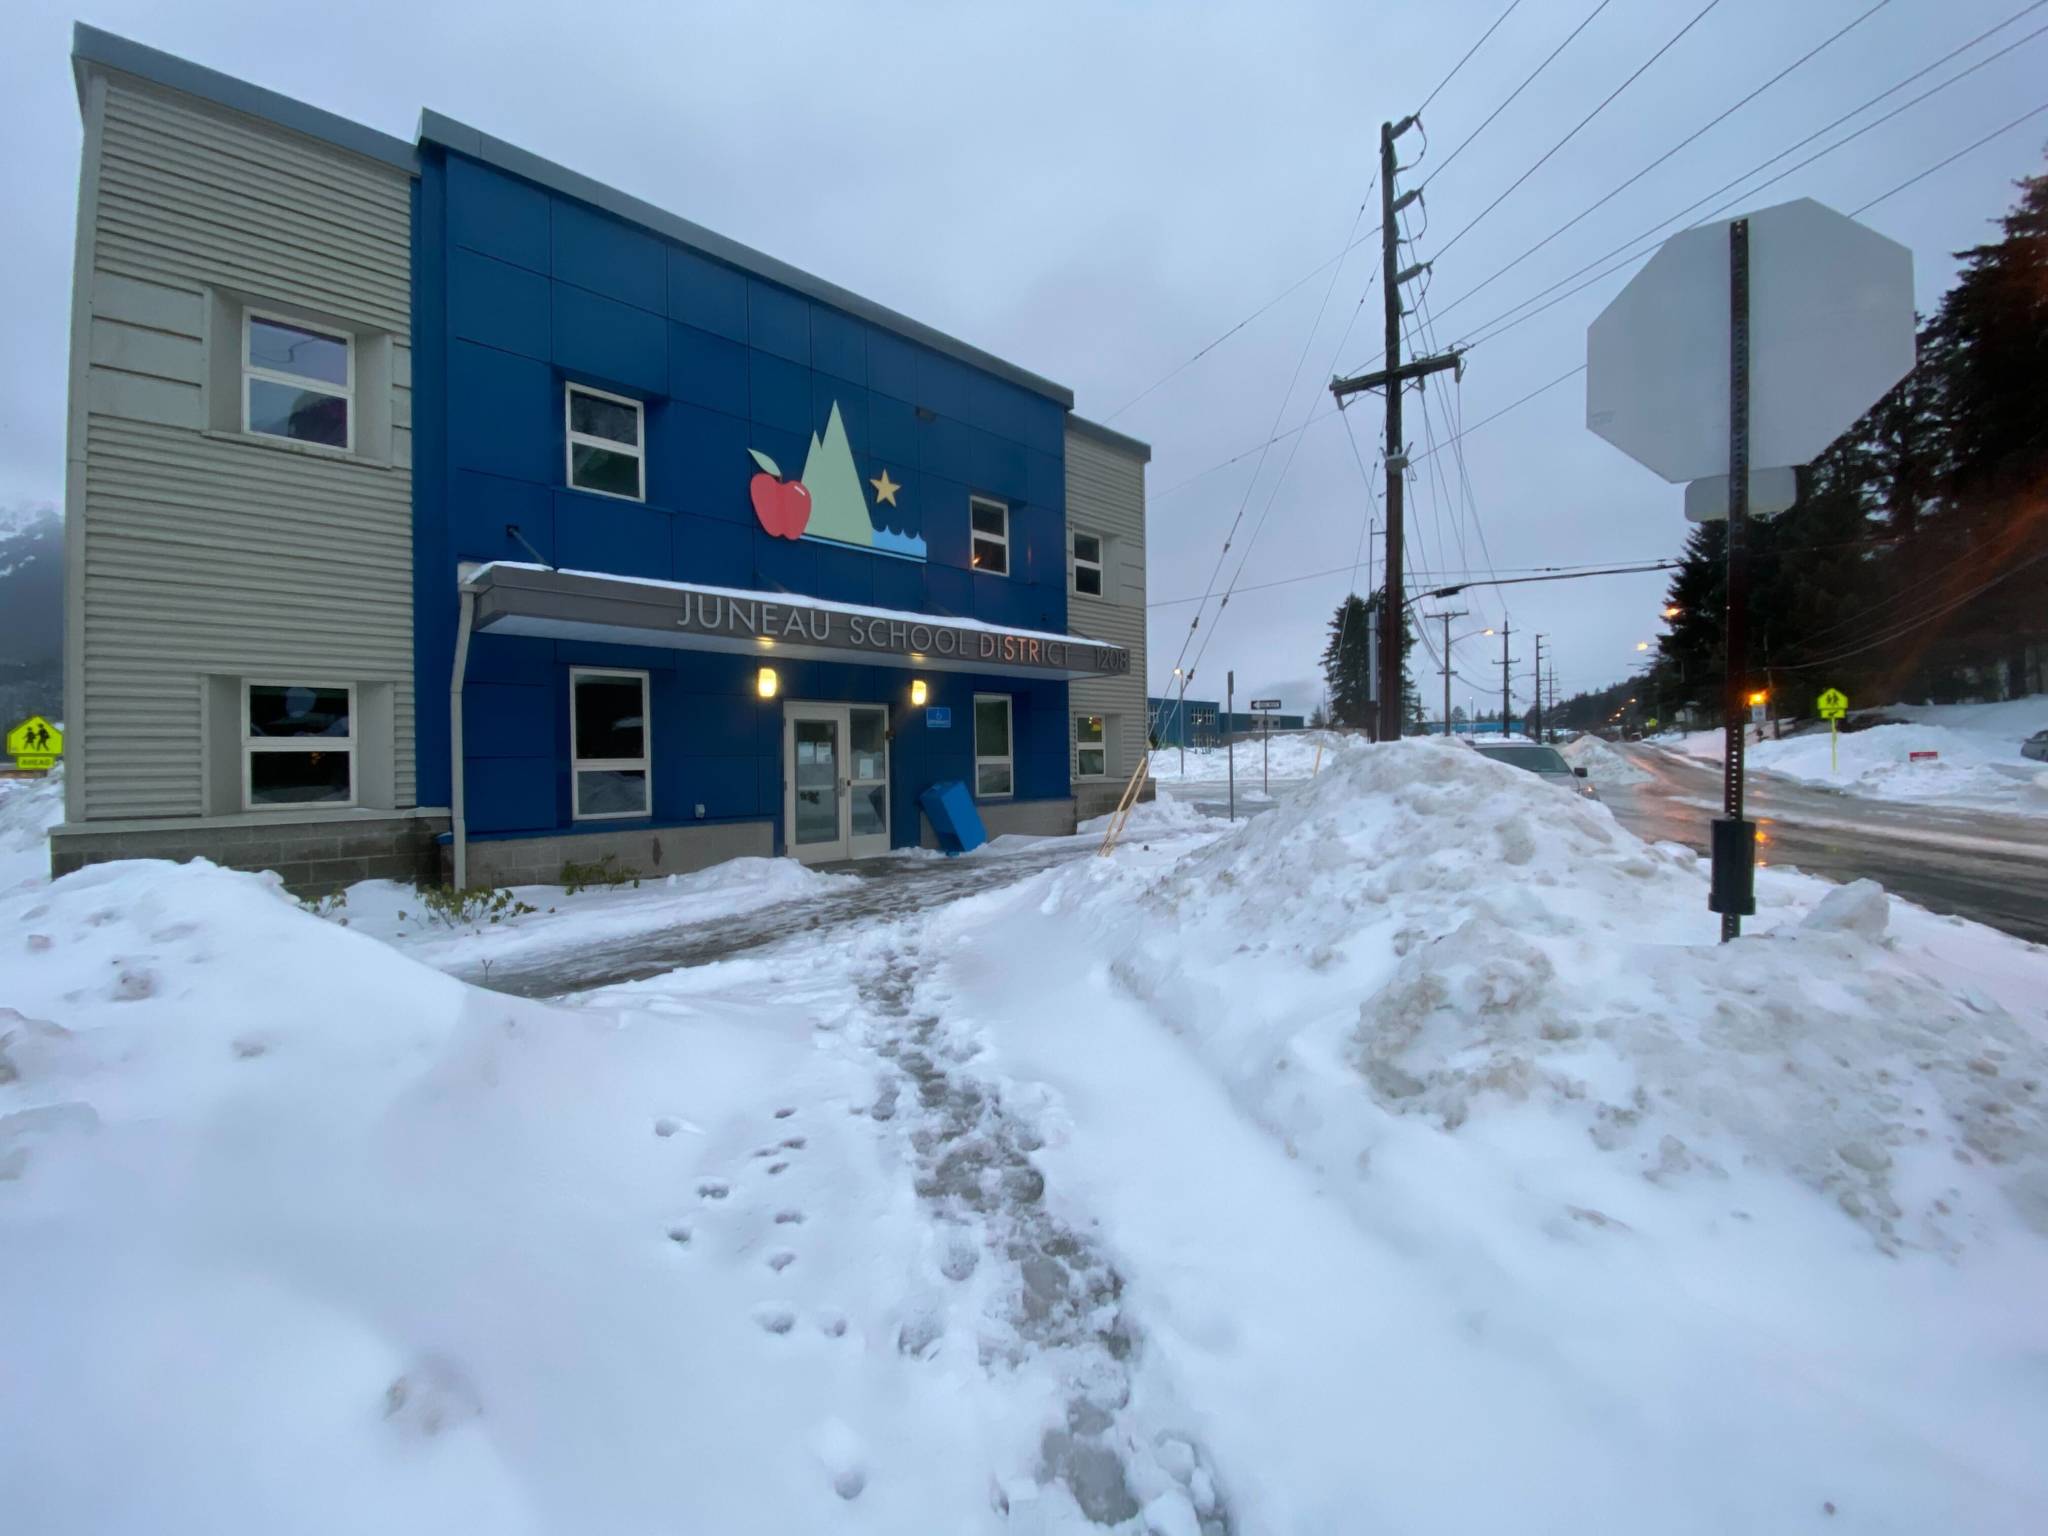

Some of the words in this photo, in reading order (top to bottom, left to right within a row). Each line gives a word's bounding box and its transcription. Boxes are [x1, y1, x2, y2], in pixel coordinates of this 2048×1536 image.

[677, 592, 830, 641] JUNEAU
[850, 616, 968, 656] SCHOOL
[980, 633, 1071, 665] DISTRICT
[1096, 647, 1130, 670] 1208
